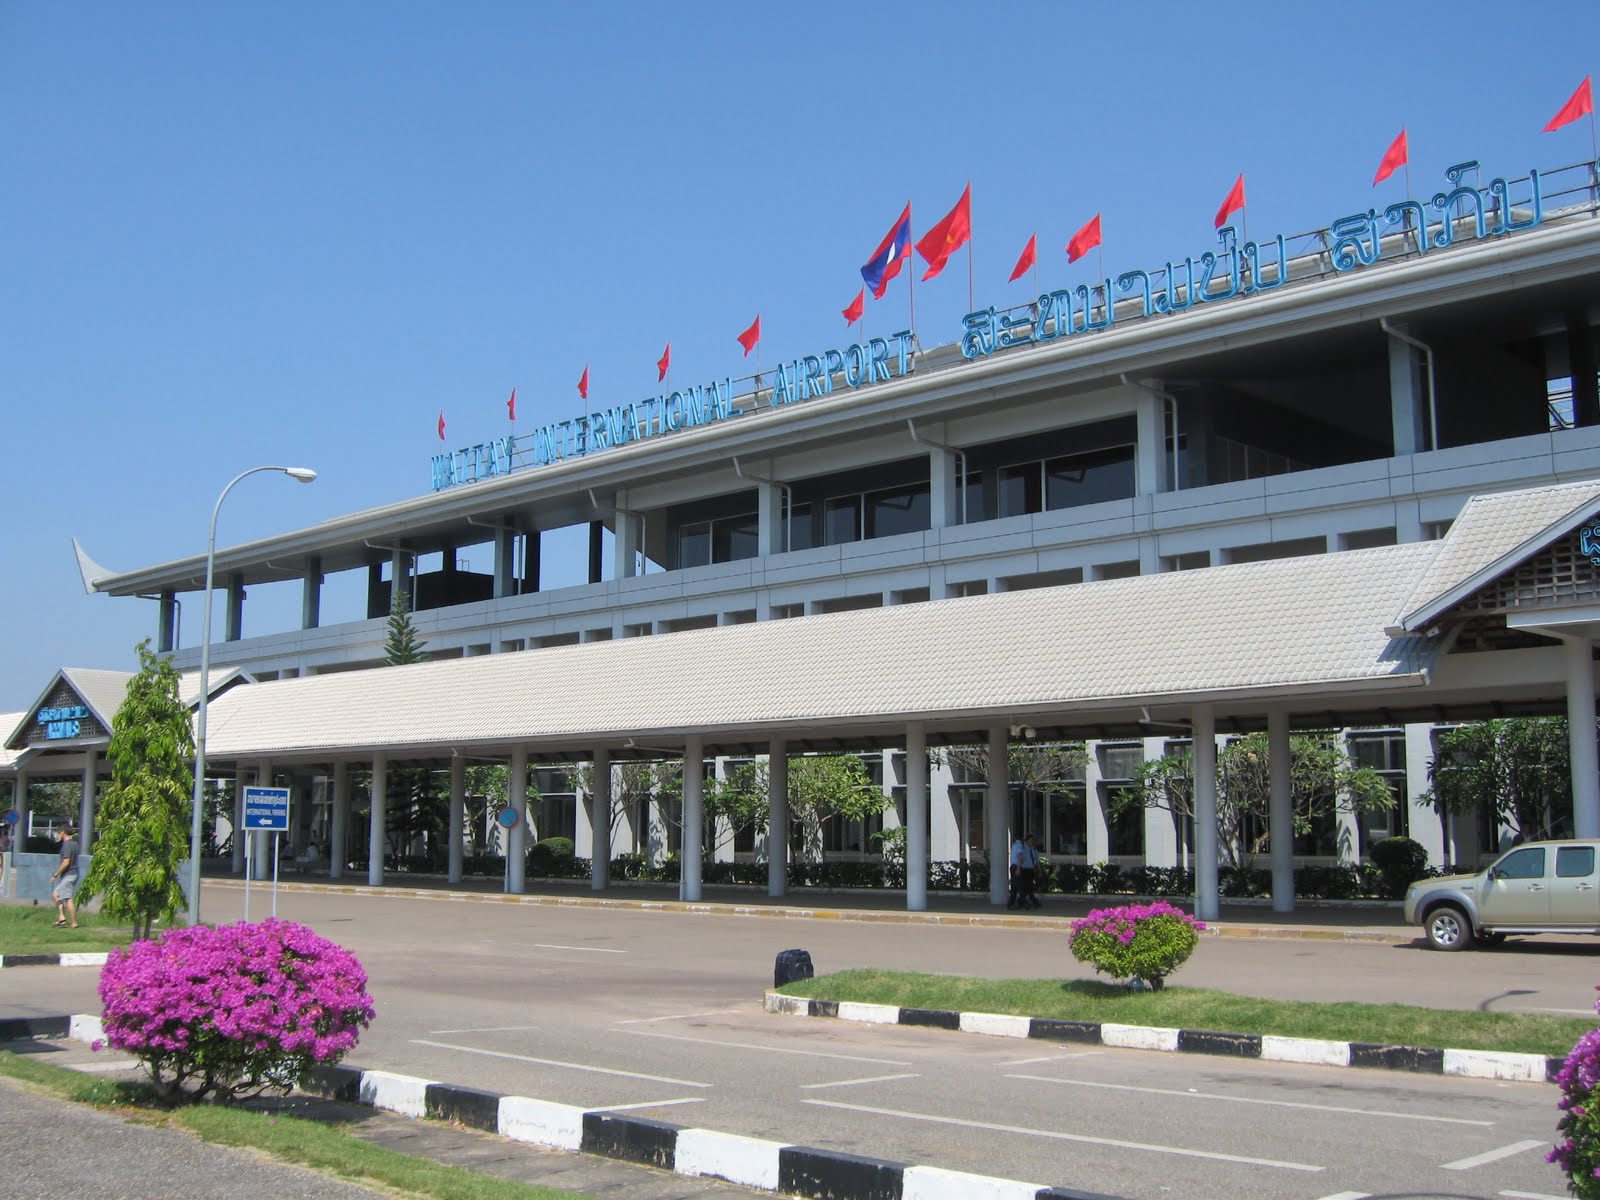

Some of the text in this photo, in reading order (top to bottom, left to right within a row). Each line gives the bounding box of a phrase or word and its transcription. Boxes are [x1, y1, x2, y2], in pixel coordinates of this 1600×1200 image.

[431, 328, 913, 491] WATTAY INTERNATIONAL AIRPORT
